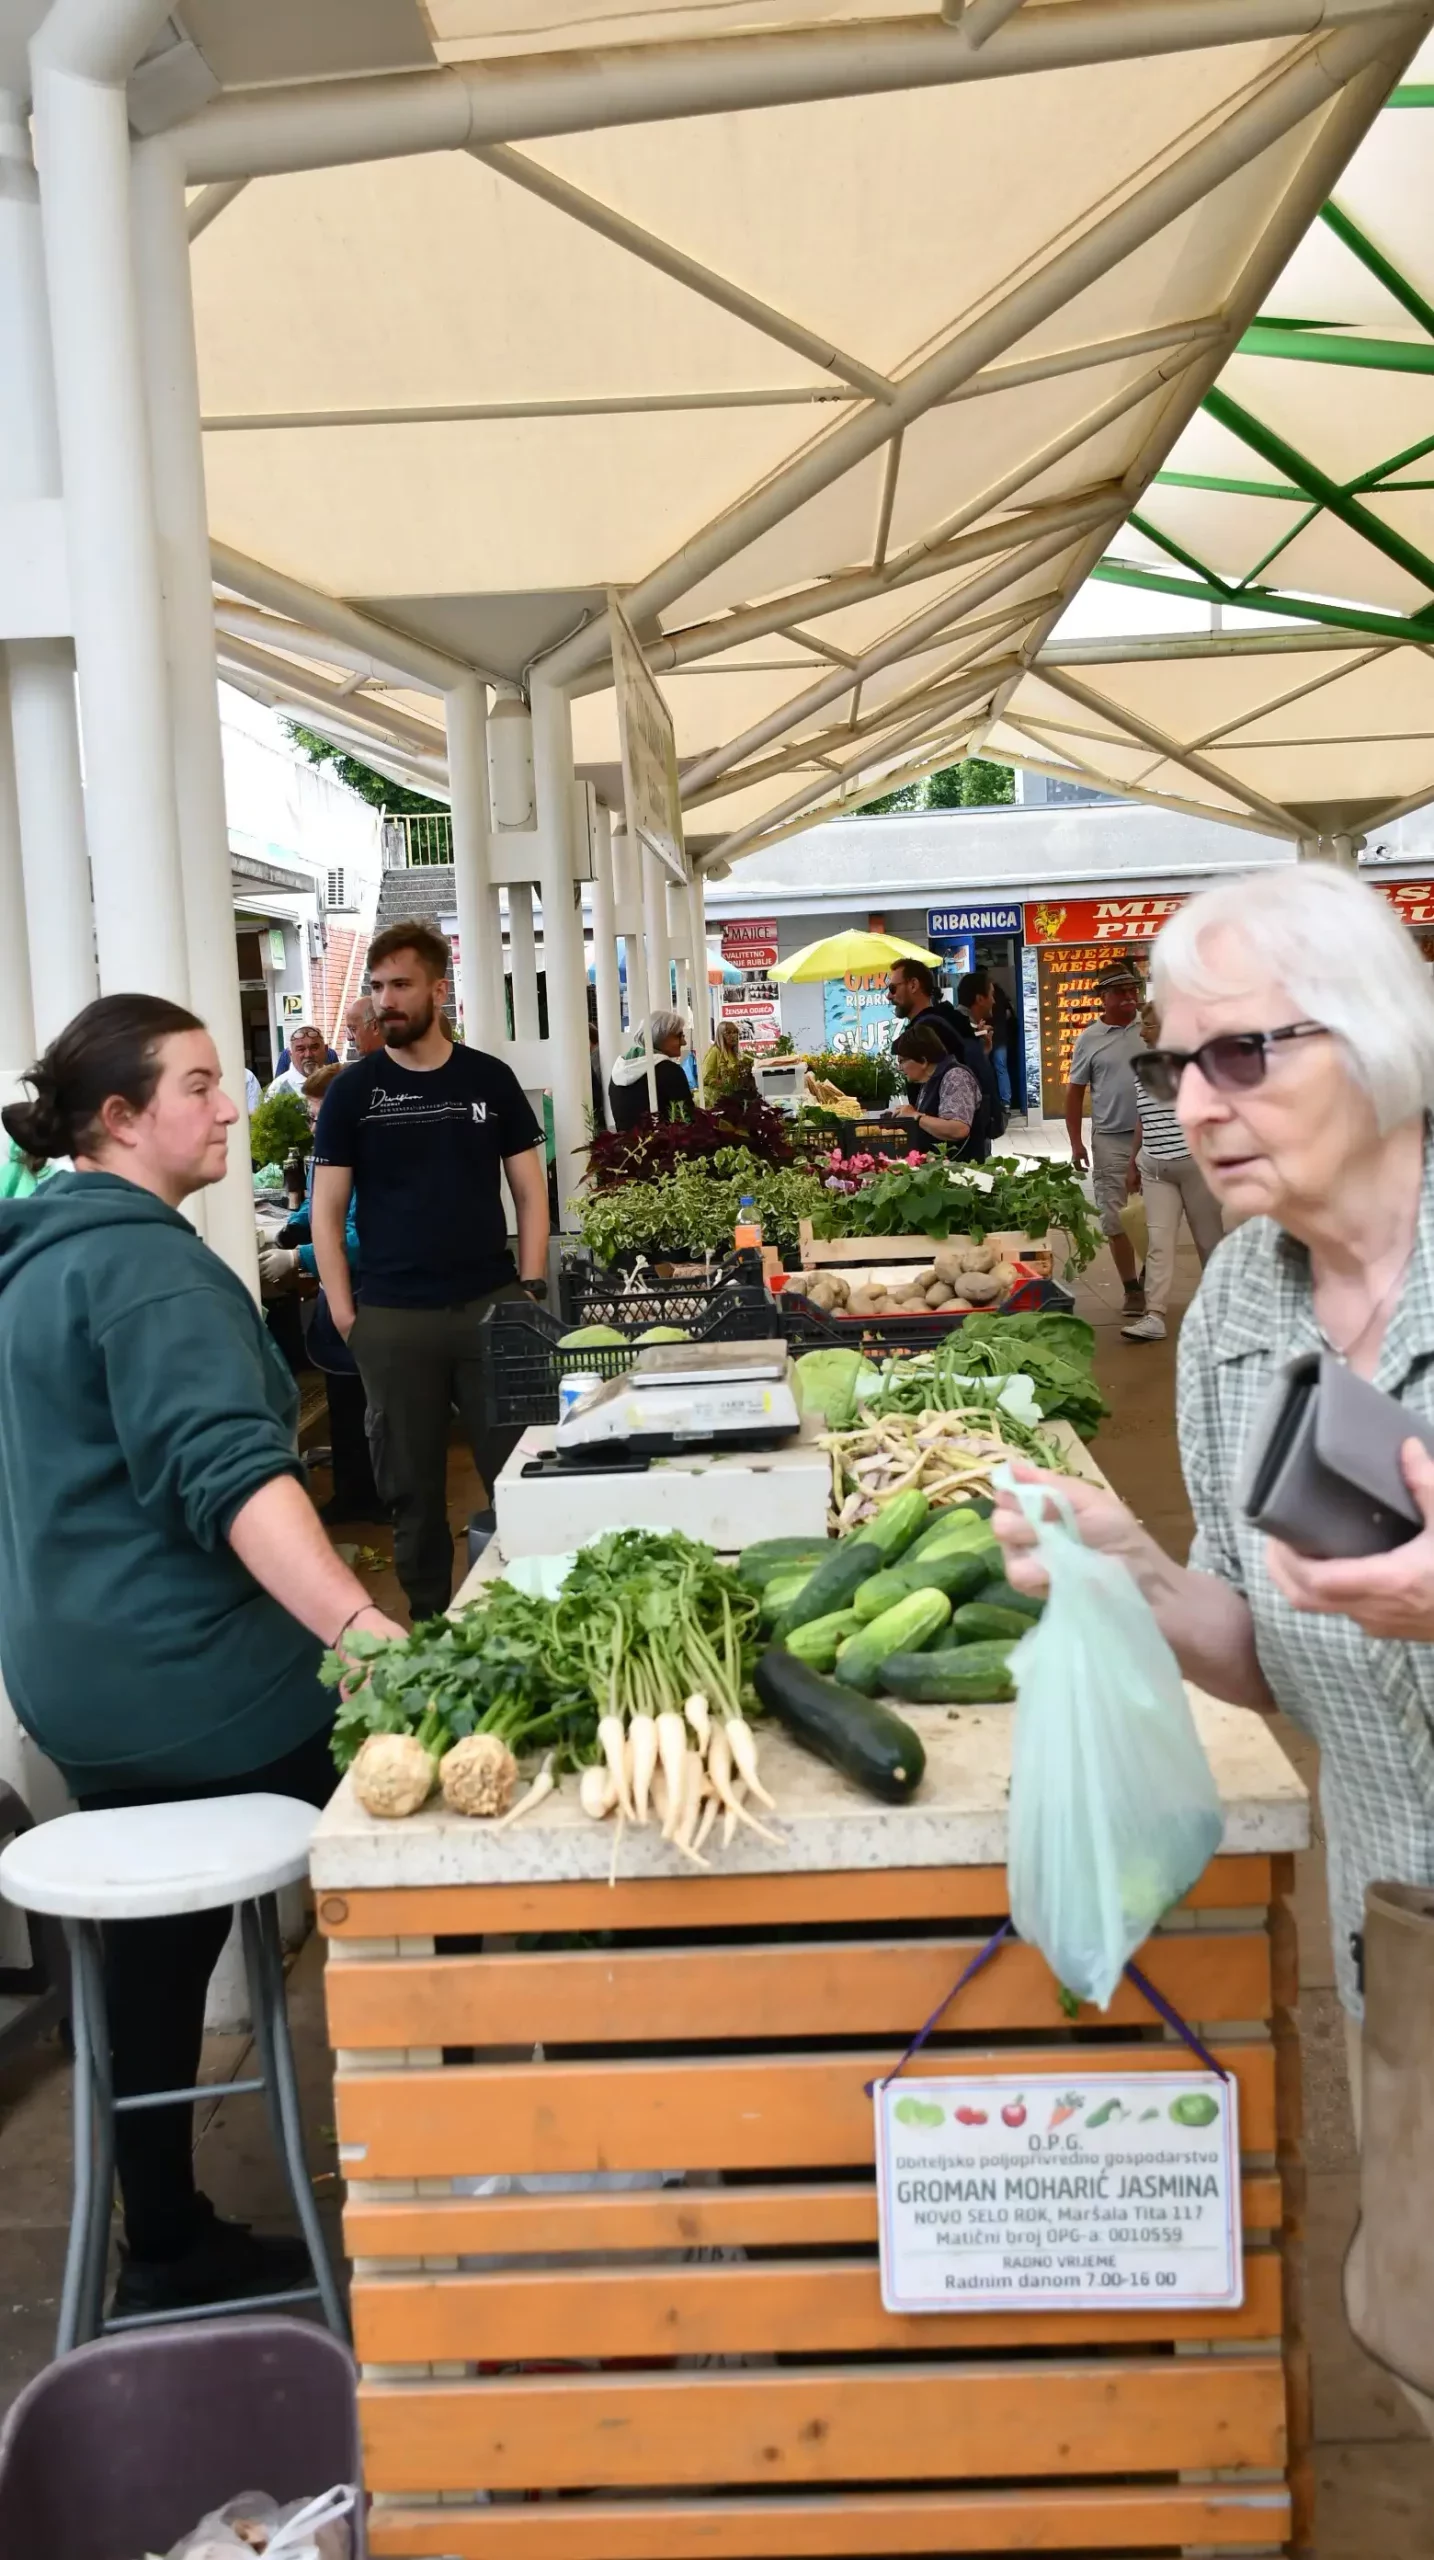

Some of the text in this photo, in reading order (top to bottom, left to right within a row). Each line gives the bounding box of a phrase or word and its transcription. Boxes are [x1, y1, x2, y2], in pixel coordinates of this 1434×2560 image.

[1093, 900, 1182, 919] ME
[932, 911, 1017, 931] RIBARNICA
[1093, 920, 1161, 939] PIL
[746, 957, 773, 967] RUBLJE
[1043, 945, 1127, 962] SVJEŽE
[846, 993, 890, 1007] RIBARN
[1057, 995, 1103, 1008] koko
[725, 1005, 748, 1015] ŽENSKA
[1059, 1028, 1083, 1041] pu
[471, 1101, 487, 1121] N
[1028, 2133, 1083, 2152] O.P.G.
[896, 2150, 1219, 2171] Obiteljsko poljoprivredno gospodarstvo
[897, 2167, 1220, 2204] GROMAN MOHARIĆ JASMINA
[914, 2205, 1203, 2225] NOVO SELO ROK, Maršala Tita 117
[936, 2229, 1001, 2245] Matični
[1006, 2228, 1041, 2247] broj
[1108, 2226, 1183, 2243] 0010559
[1003, 2254, 1117, 2269] RADNO VRIJEME
[944, 2274, 1013, 2289] Radnim
[1018, 2273, 1081, 2289] danom
